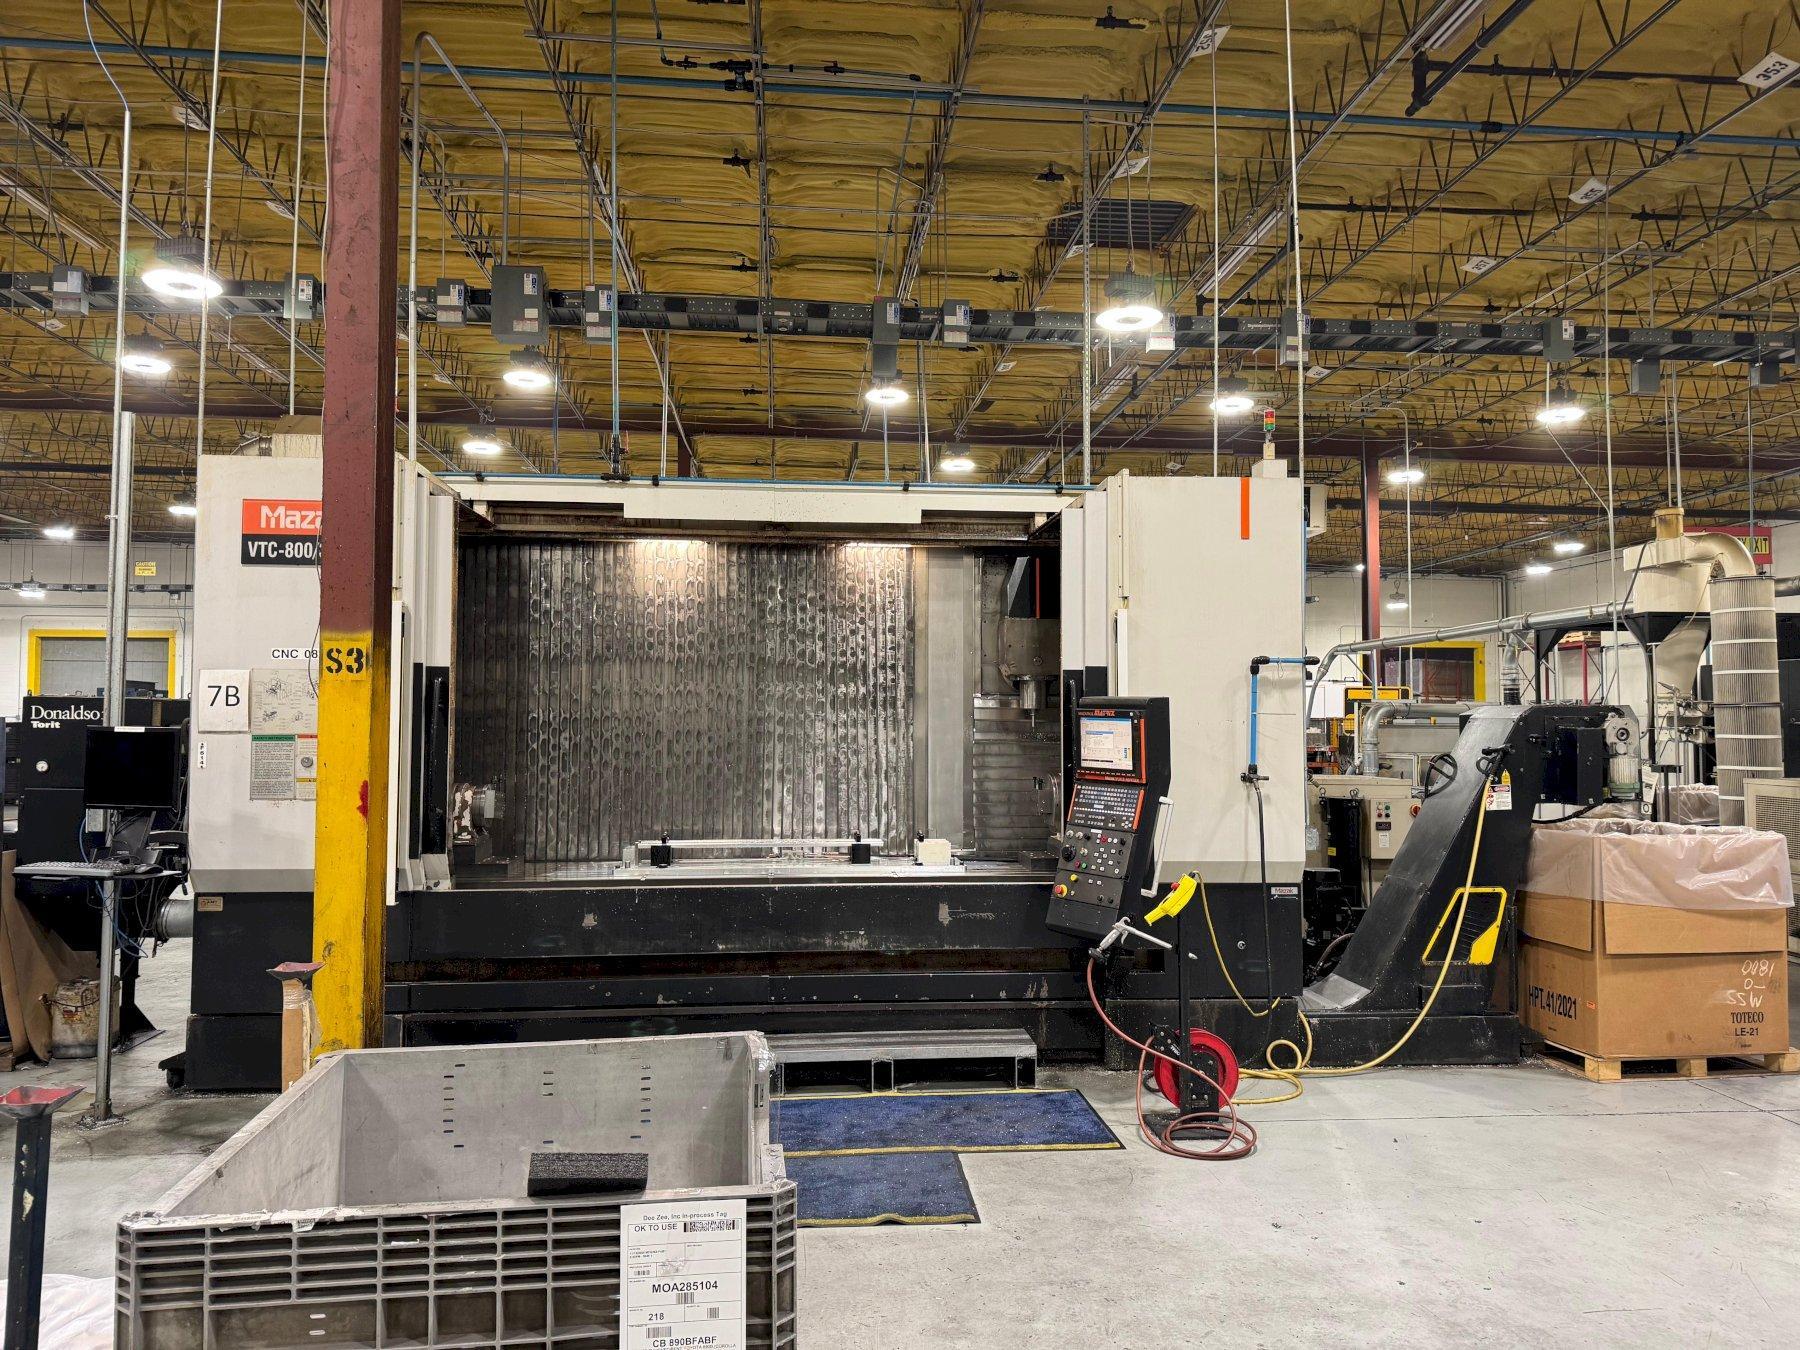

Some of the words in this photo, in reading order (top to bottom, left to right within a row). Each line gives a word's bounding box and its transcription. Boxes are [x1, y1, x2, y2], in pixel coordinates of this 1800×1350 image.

[1756, 61, 1788, 81] 353
[248, 541, 322, 560] VTC-800/
[271, 649, 299, 659] CNC
[325, 647, 365, 675] S3
[207, 685, 241, 707] 7B
[30, 705, 105, 720] Donaldso
[31, 720, 61, 729] Torit
[1731, 1011, 1764, 1023] TOTECO
[1735, 1028, 1759, 1036] LE-21
[662, 1223, 678, 1231] USE
[652, 1280, 718, 1293] MOA285104
[648, 1312, 664, 1320] 218
[652, 1339, 666, 1348] CB
[670, 1336, 717, 1347] 890BFABF
